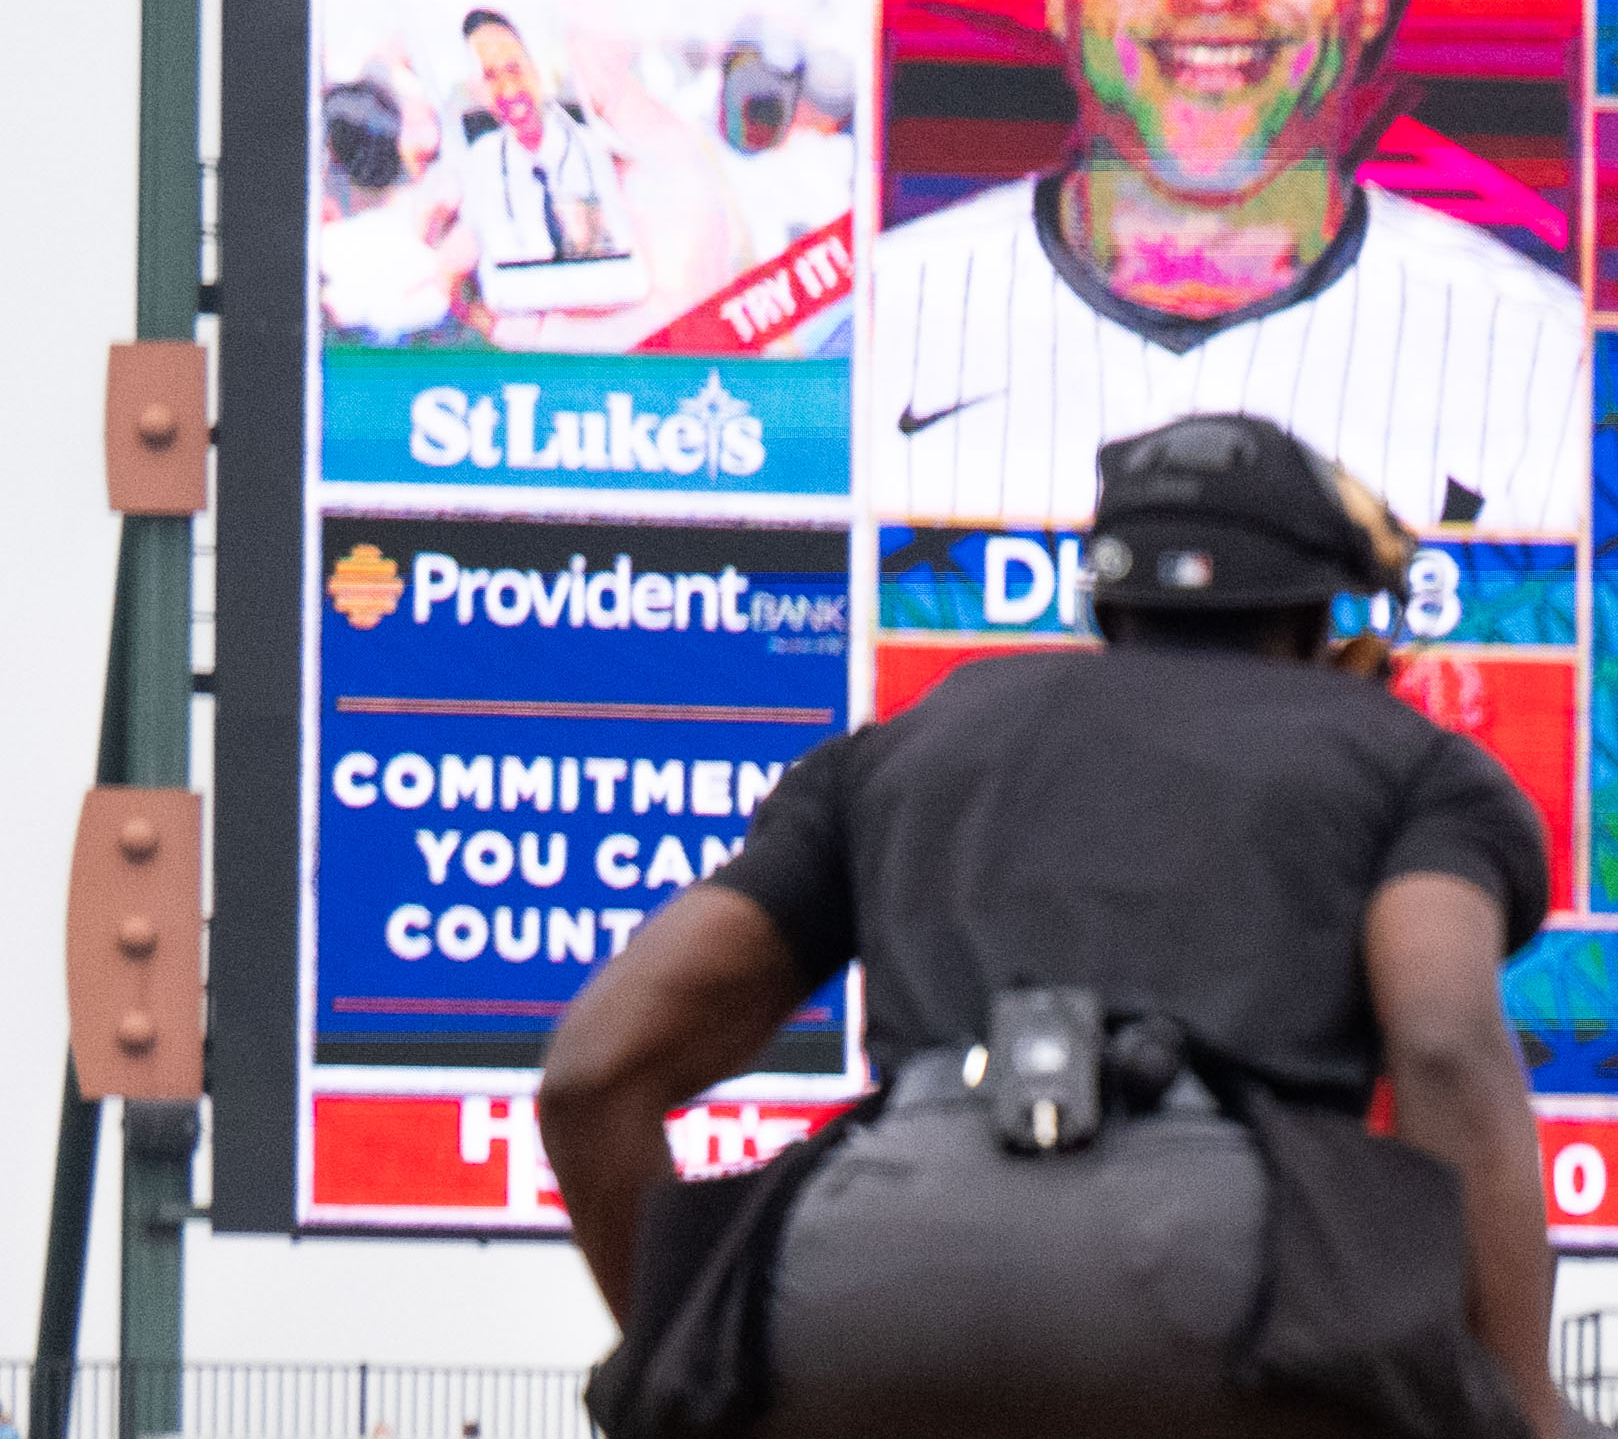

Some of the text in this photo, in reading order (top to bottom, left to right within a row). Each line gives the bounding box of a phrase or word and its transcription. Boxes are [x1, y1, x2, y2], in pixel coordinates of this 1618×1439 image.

[718, 268, 798, 344] TRY
[412, 550, 848, 633] Provident BANK
[332, 750, 801, 819] COMMITMEN
[415, 827, 568, 888] YOU
[386, 904, 645, 964] COUNT
